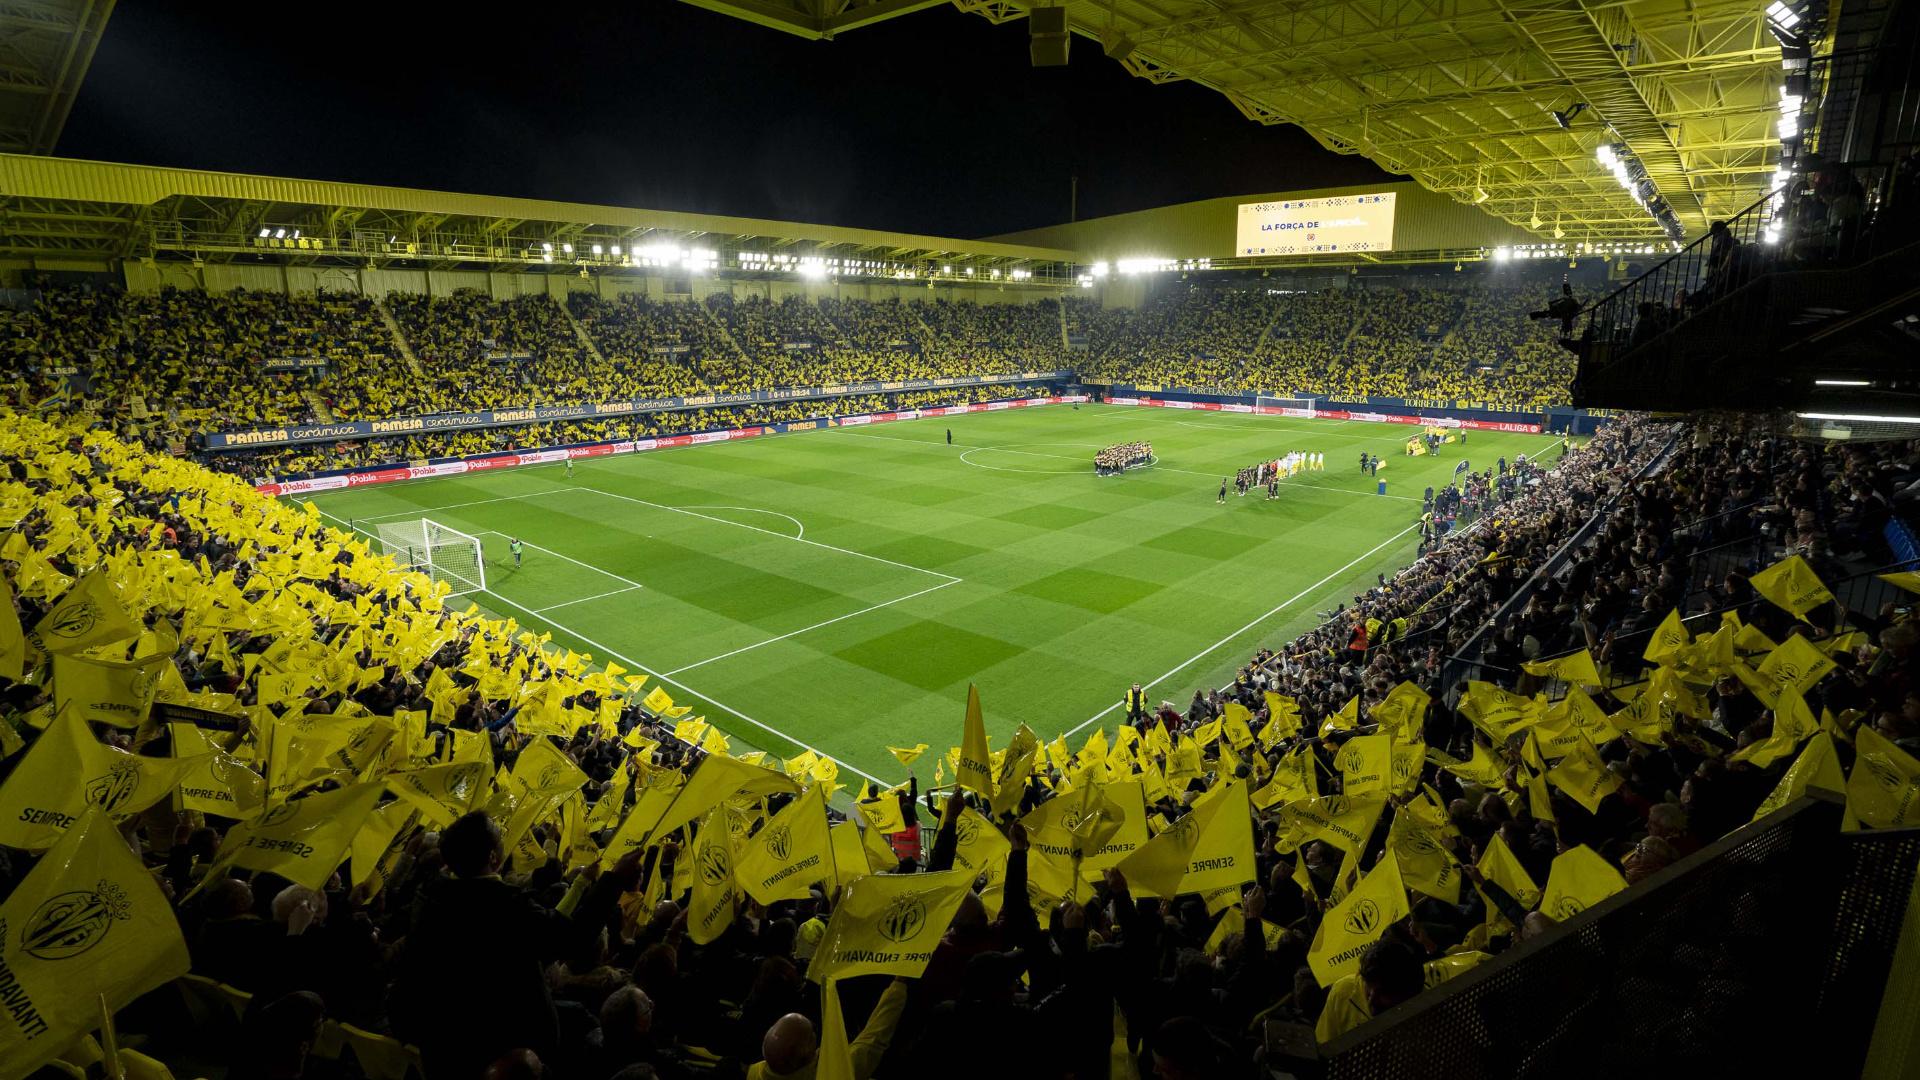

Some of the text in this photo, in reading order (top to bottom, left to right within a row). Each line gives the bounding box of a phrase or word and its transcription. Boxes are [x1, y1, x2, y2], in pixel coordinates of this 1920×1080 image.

[1261, 224, 1273, 232] LA
[1274, 222, 1304, 231] FORÇA
[1307, 221, 1319, 229] DE
[1188, 387, 1244, 397] PORCELANOSA
[683, 396, 716, 406] PAMESA
[1328, 394, 1369, 404] ARGENTA
[1403, 398, 1449, 409] TORRECID
[595, 402, 633, 414] PAMESA
[493, 411, 537, 422] PAMESA
[372, 419, 423, 433] PAMESA
[787, 421, 817, 431] PAMESA
[1499, 423, 1528, 432] LALIGA
[225, 430, 289, 445] PAMESA
[412, 466, 437, 477] Poble
[349, 473, 377, 484] Poble
[282, 482, 312, 493] Poble
